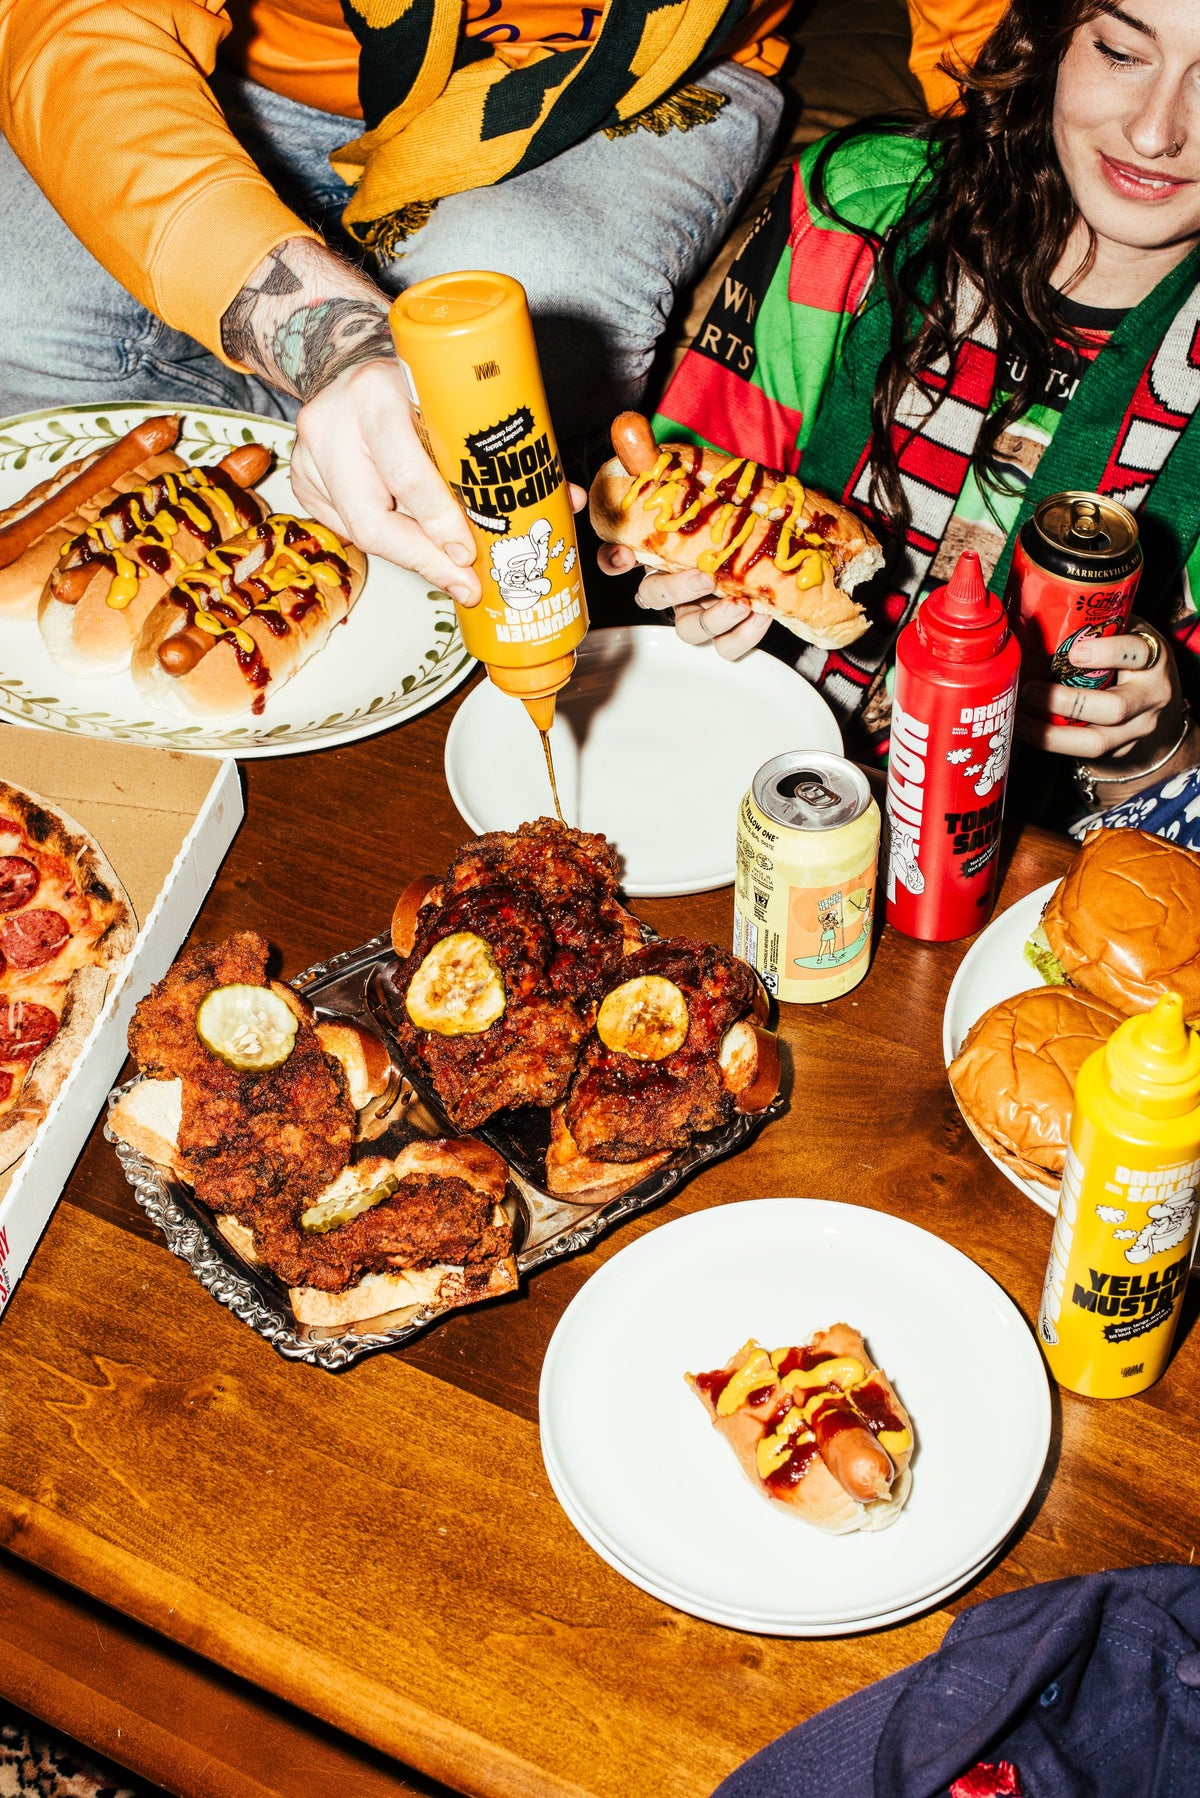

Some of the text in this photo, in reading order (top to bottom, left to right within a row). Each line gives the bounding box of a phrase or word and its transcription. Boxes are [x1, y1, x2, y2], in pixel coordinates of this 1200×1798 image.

[460, 432, 551, 486] HONEY
[495, 597, 581, 643] DRUNKEN
[504, 587, 571, 625] SAILOR
[746, 806, 762, 831] YELLOW
[1072, 1275, 1187, 1317] MUSTAR
